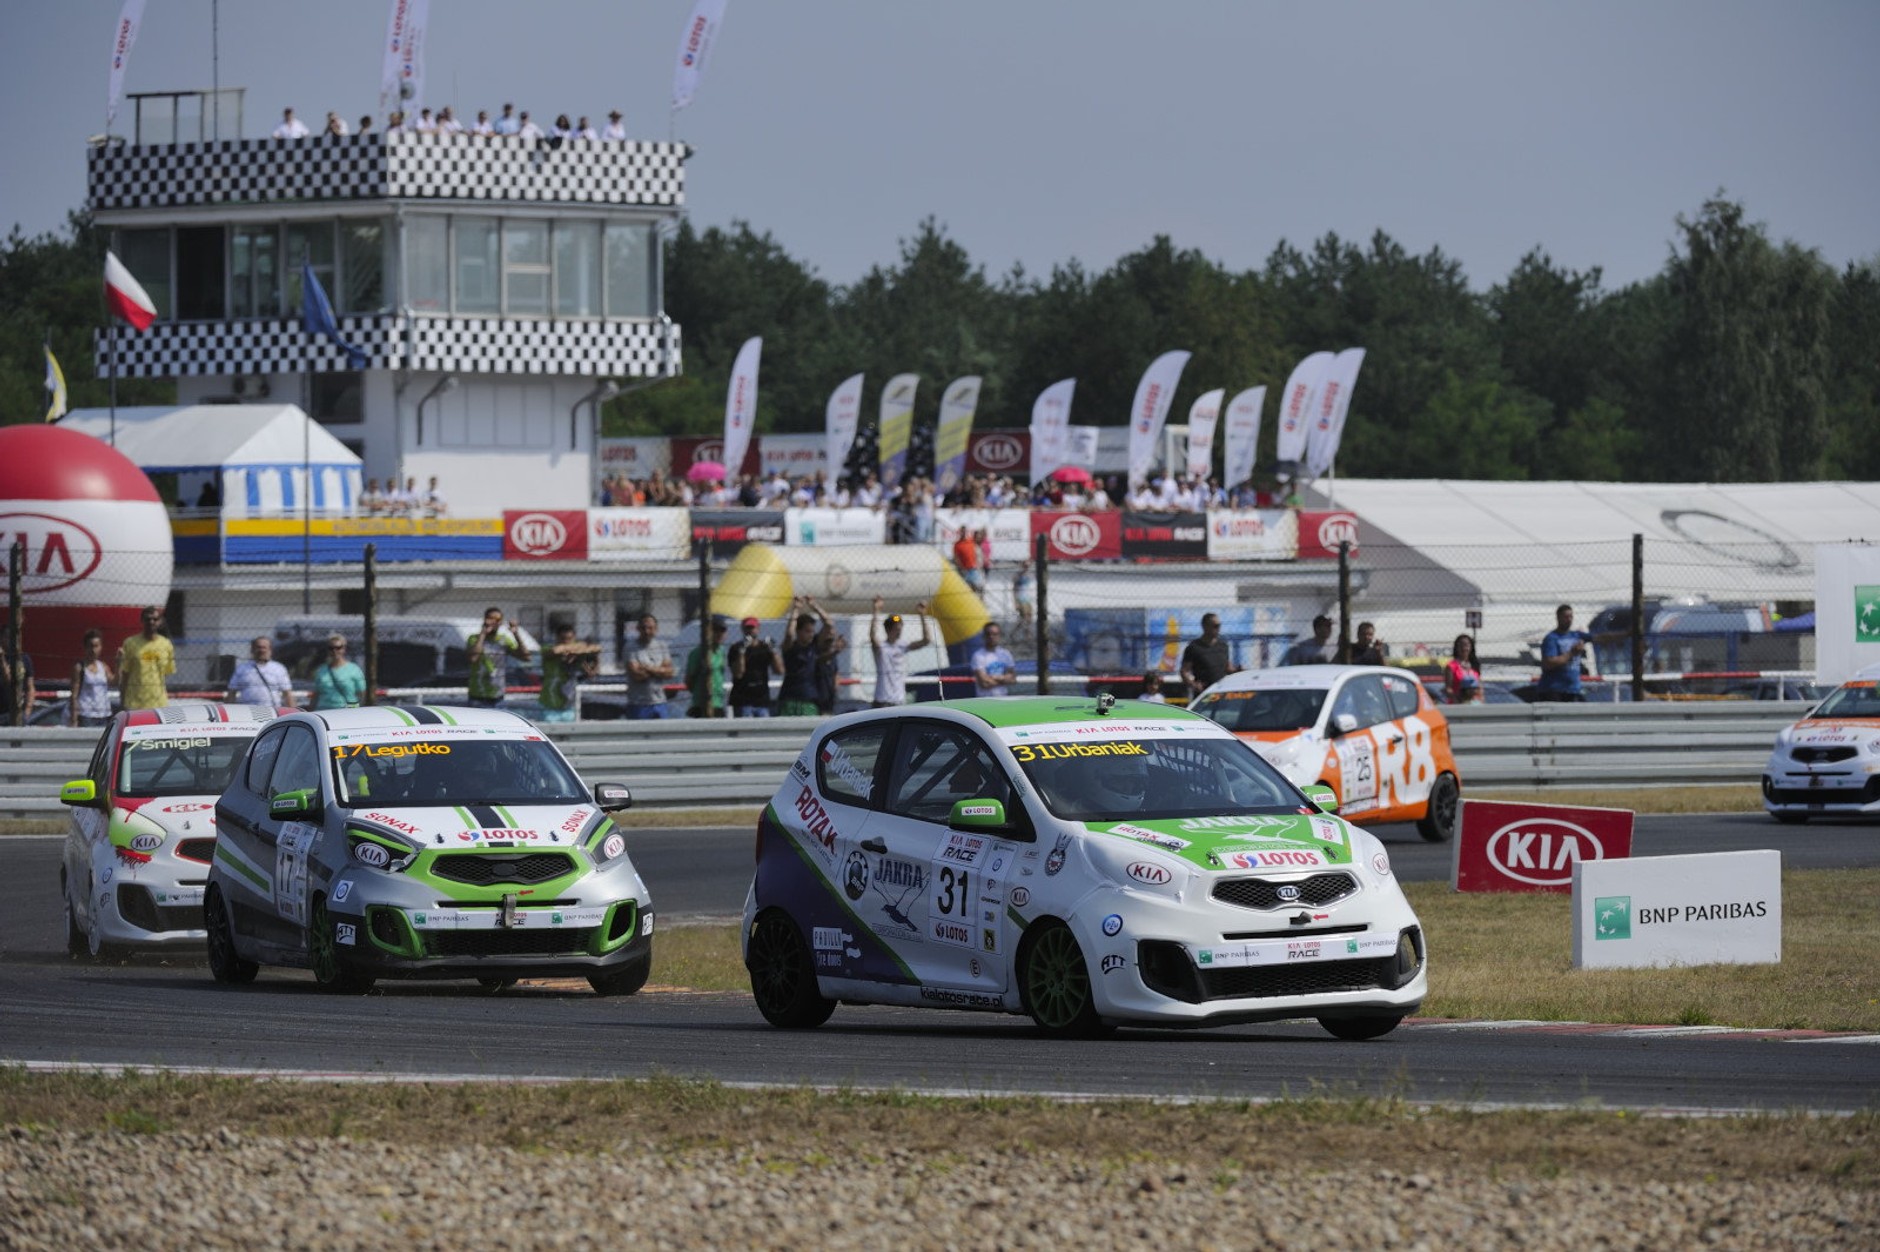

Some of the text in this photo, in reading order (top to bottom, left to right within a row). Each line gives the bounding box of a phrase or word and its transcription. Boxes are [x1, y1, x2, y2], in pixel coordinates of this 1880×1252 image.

[688, 15, 706, 53] LOTOS
[1142, 383, 1161, 419] LOTOS
[1288, 383, 1307, 418] LOTOS
[1321, 381, 1340, 417] LOTOS
[980, 443, 1013, 460] KIA
[519, 522, 557, 547] KIA
[611, 519, 652, 538] LOTOS
[1059, 522, 1091, 546] KIA
[1174, 527, 1205, 540] RACE
[1230, 519, 1265, 537] LOTOS
[1326, 524, 1356, 545] KIA
[0, 531, 75, 577] IA
[1357, 755, 1372, 782] 25
[1369, 715, 1437, 809] R8
[364, 812, 422, 835] SONAX
[560, 808, 589, 833] SONAX
[795, 784, 838, 856] ROTAX
[482, 829, 539, 840] LOTOS
[950, 834, 983, 850] KIA LOTOS
[1118, 826, 1161, 840] ROTAX
[135, 838, 157, 848] KIA
[607, 838, 624, 855] KIA
[1506, 832, 1582, 871] KIA
[360, 847, 383, 861] KIA
[943, 846, 977, 862] RACE
[1258, 852, 1319, 866] LOTOS
[874, 858, 922, 889] JAKRA
[1376, 857, 1387, 871] KIA
[1133, 867, 1162, 882] KIA
[937, 866, 968, 917] 31
[1013, 890, 1028, 902] KIA
[1280, 888, 1299, 898] KIA
[494, 918, 525, 926] RCE
[1639, 901, 1767, 925] BNP PARIBAS
[946, 924, 969, 943] LOTOS
[1372, 939, 1397, 947] PARIBAS
[1101, 955, 1127, 972] ATT
[1287, 949, 1319, 960] RACE
[920, 986, 1004, 1008] kialotosrace.pl
